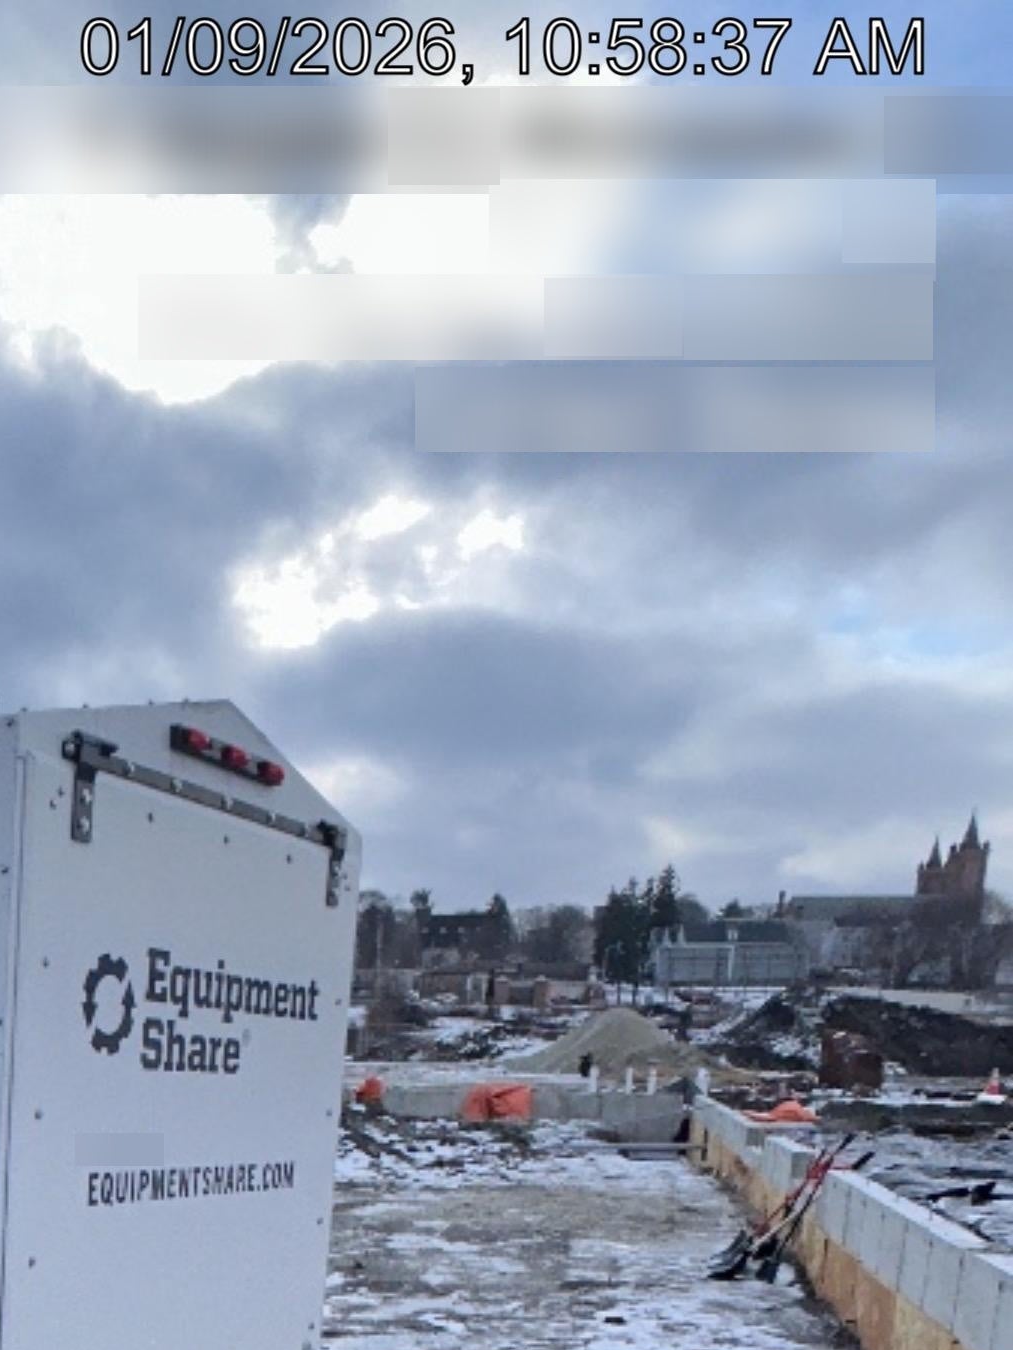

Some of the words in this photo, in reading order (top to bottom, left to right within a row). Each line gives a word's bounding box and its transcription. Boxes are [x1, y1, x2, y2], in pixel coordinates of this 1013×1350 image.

[145, 947, 320, 1024] Equipment
[140, 1017, 241, 1075] Share
[87, 1160, 296, 1207] EQUIPMENTSHARE.COM
